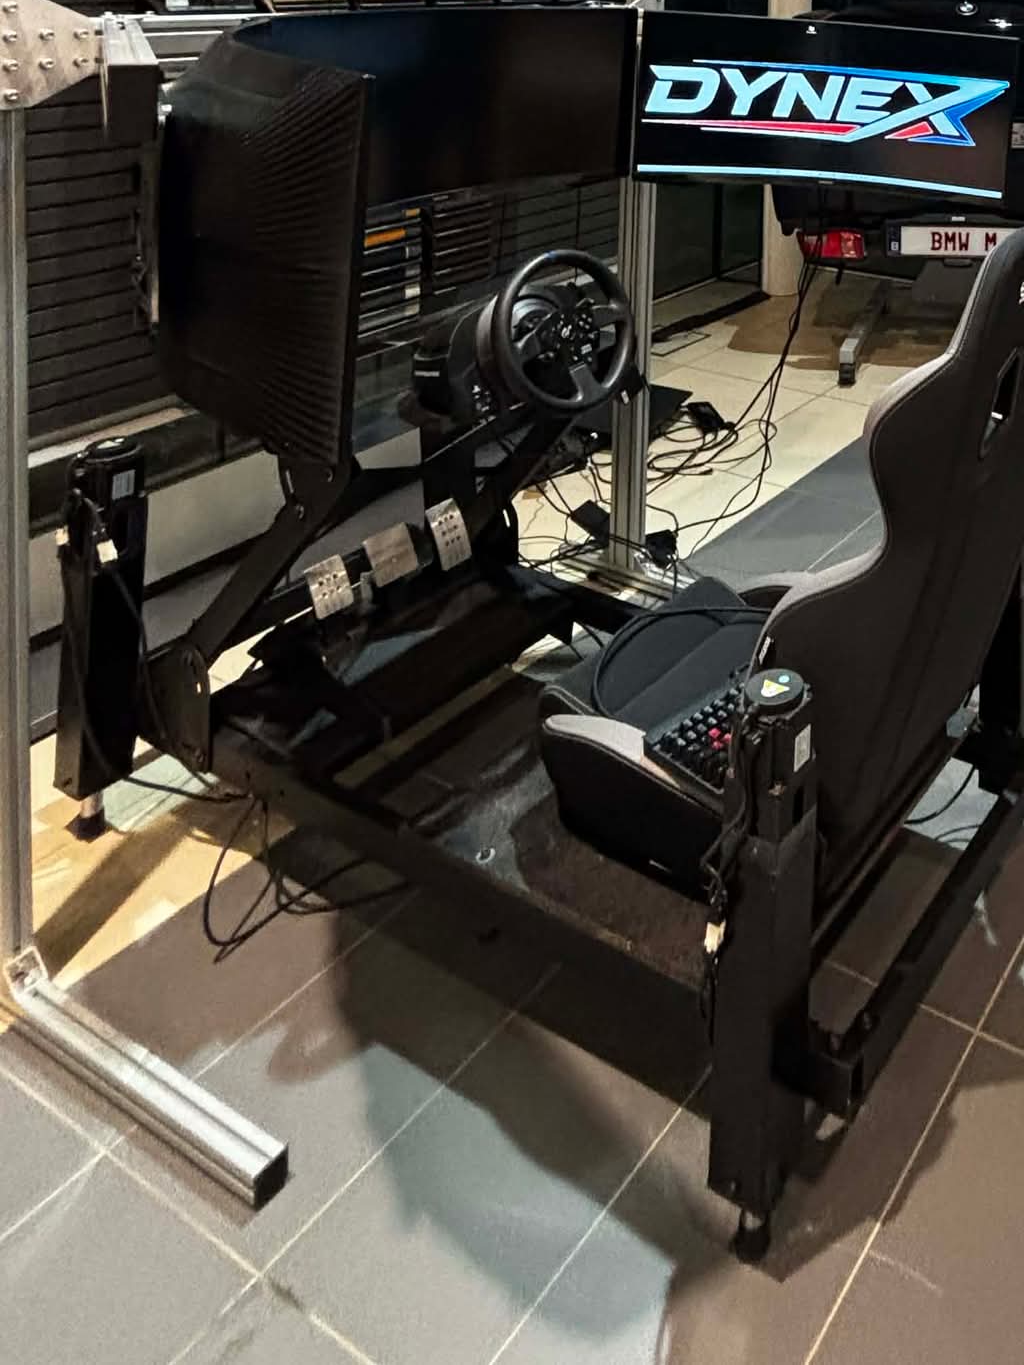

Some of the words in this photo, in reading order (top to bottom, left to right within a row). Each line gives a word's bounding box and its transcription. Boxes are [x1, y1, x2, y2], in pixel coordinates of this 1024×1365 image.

[645, 64, 1009, 143] DYNEX
[931, 232, 970, 251] BMW
[984, 232, 997, 251] M
